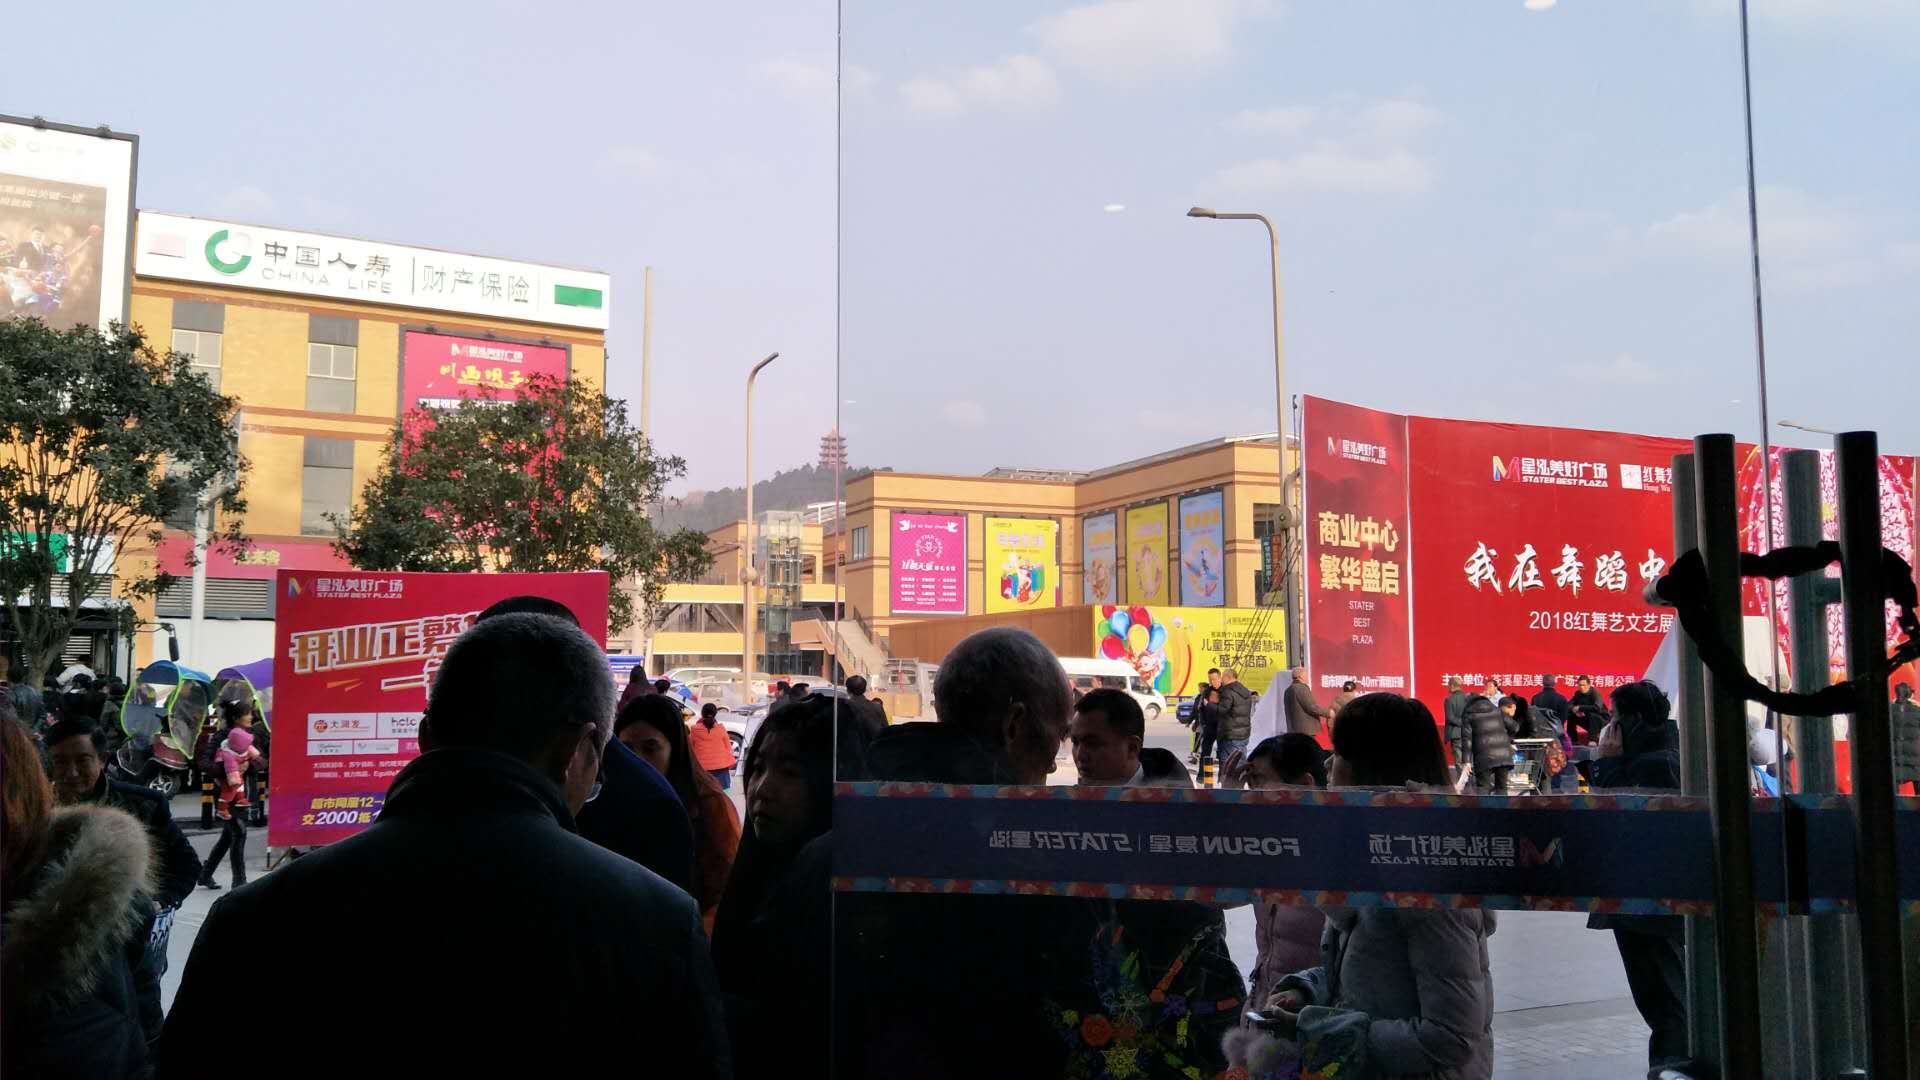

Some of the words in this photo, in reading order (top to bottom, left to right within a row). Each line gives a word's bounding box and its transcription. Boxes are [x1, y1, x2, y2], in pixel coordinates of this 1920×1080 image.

[262, 267, 331, 286] CHINA
[348, 278, 392, 294] LIFE
[264, 240, 391, 277] 中国人寿
[422, 264, 530, 303] 财产保险
[1521, 457, 1608, 479] 星泓美好广场
[1522, 476, 1556, 484] STATER
[1556, 478, 1577, 486] BEST
[1579, 479, 1608, 488] PLAZA
[1319, 511, 1399, 552] 商业中心
[1320, 554, 1399, 595] 繁华盛启
[1464, 541, 1666, 597] 我在舞蹈中
[317, 578, 403, 593] 星泓美好广场
[1349, 600, 1375, 611] STATER
[1353, 617, 1371, 628] BEST
[289, 610, 482, 674] 开业正繁
[1352, 635, 1374, 644] PLAZA
